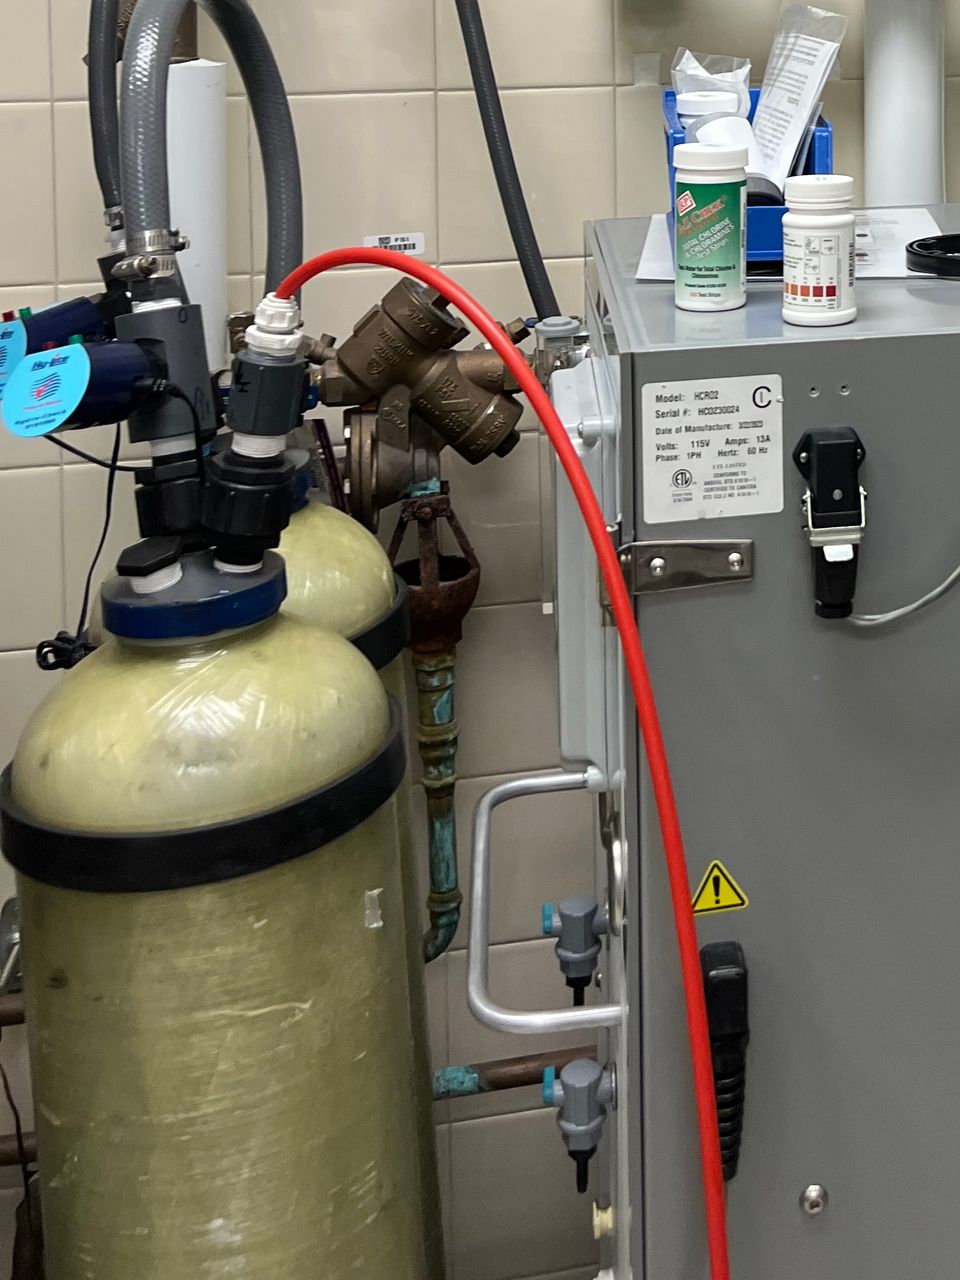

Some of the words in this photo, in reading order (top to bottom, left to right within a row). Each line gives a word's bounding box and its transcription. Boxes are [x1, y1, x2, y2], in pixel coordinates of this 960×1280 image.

[655, 393, 685, 403] Model:
[655, 410, 680, 419] Serial
[682, 407, 691, 417] #:
[655, 426, 672, 435] Date
[675, 425, 682, 434] of
[684, 423, 733, 433] Manufacture:
[655, 442, 678, 451] Volts:
[690, 439, 711, 448] 115V
[725, 437, 750, 447] Amps:
[756, 434, 771, 443] 13A
[655, 454, 681, 462] Phase:
[717, 449, 740, 458] Hertz:
